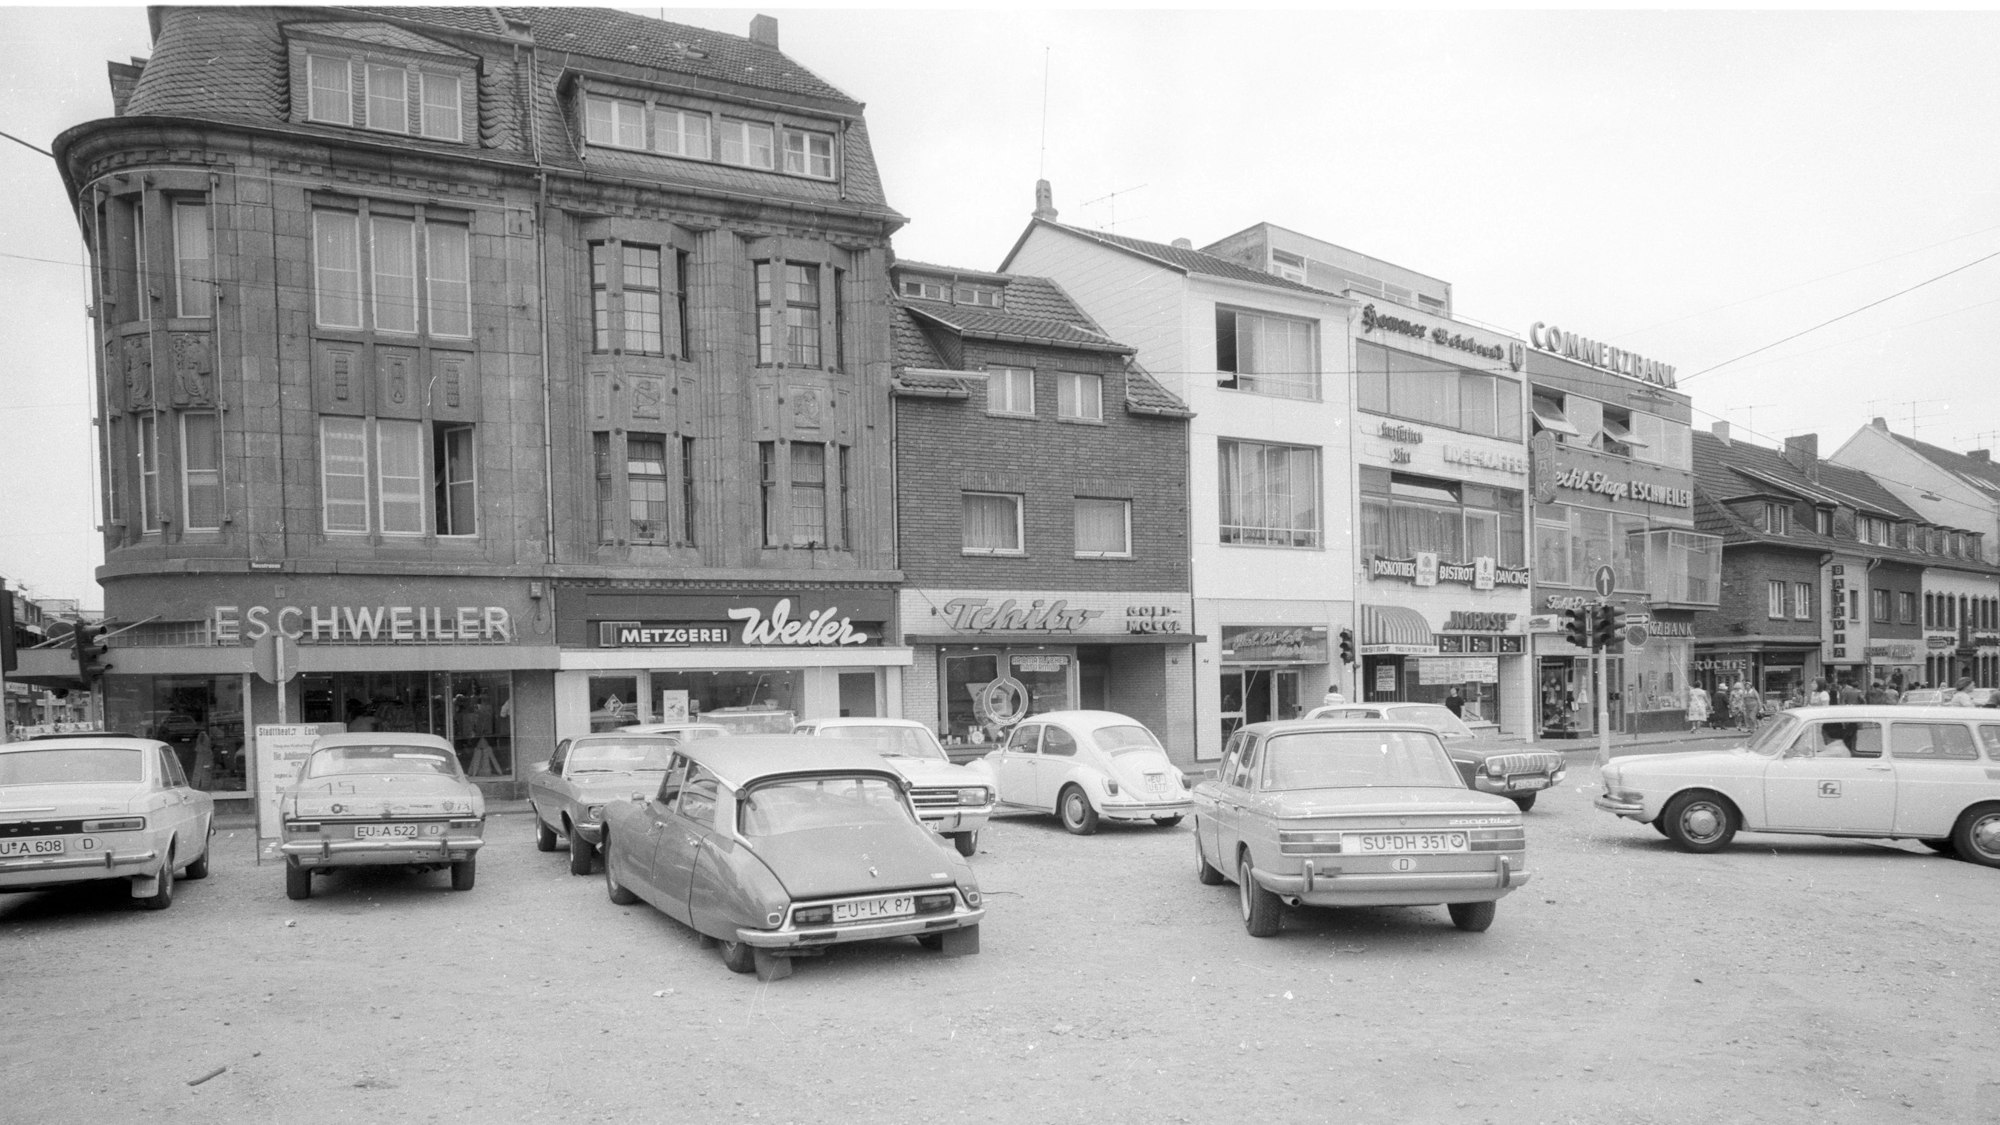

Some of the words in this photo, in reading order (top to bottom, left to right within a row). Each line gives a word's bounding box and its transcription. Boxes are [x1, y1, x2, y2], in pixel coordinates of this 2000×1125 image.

[1530, 321, 1678, 389] COMMERZBANK
[1535, 437, 1549, 496] DAK
[1556, 467, 1628, 501] extil-Etage
[1631, 480, 1692, 508] ESCHWEILER
[1374, 560, 1416, 577] DISKOTHEK
[1439, 566, 1475, 581] BISTROT
[1496, 570, 1529, 584] DANCING
[944, 597, 1104, 630] Tchibo
[1834, 566, 1844, 656] BATAVIA
[215, 606, 510, 642] ESCHWEILER
[621, 628, 727, 643] METZGEREI
[728, 598, 867, 645] Weiler
[1126, 620, 1180, 631] MOCCA
[1650, 621, 1693, 636] RZBANK
[357, 826, 392, 837] EU-A
[394, 825, 416, 836] 522
[430, 826, 439, 835] D
[35, 840, 62, 853] 608
[83, 838, 94, 850] D
[1421, 834, 1447, 849] 351
[1400, 858, 1409, 871] D
[894, 897, 912, 912] 87
